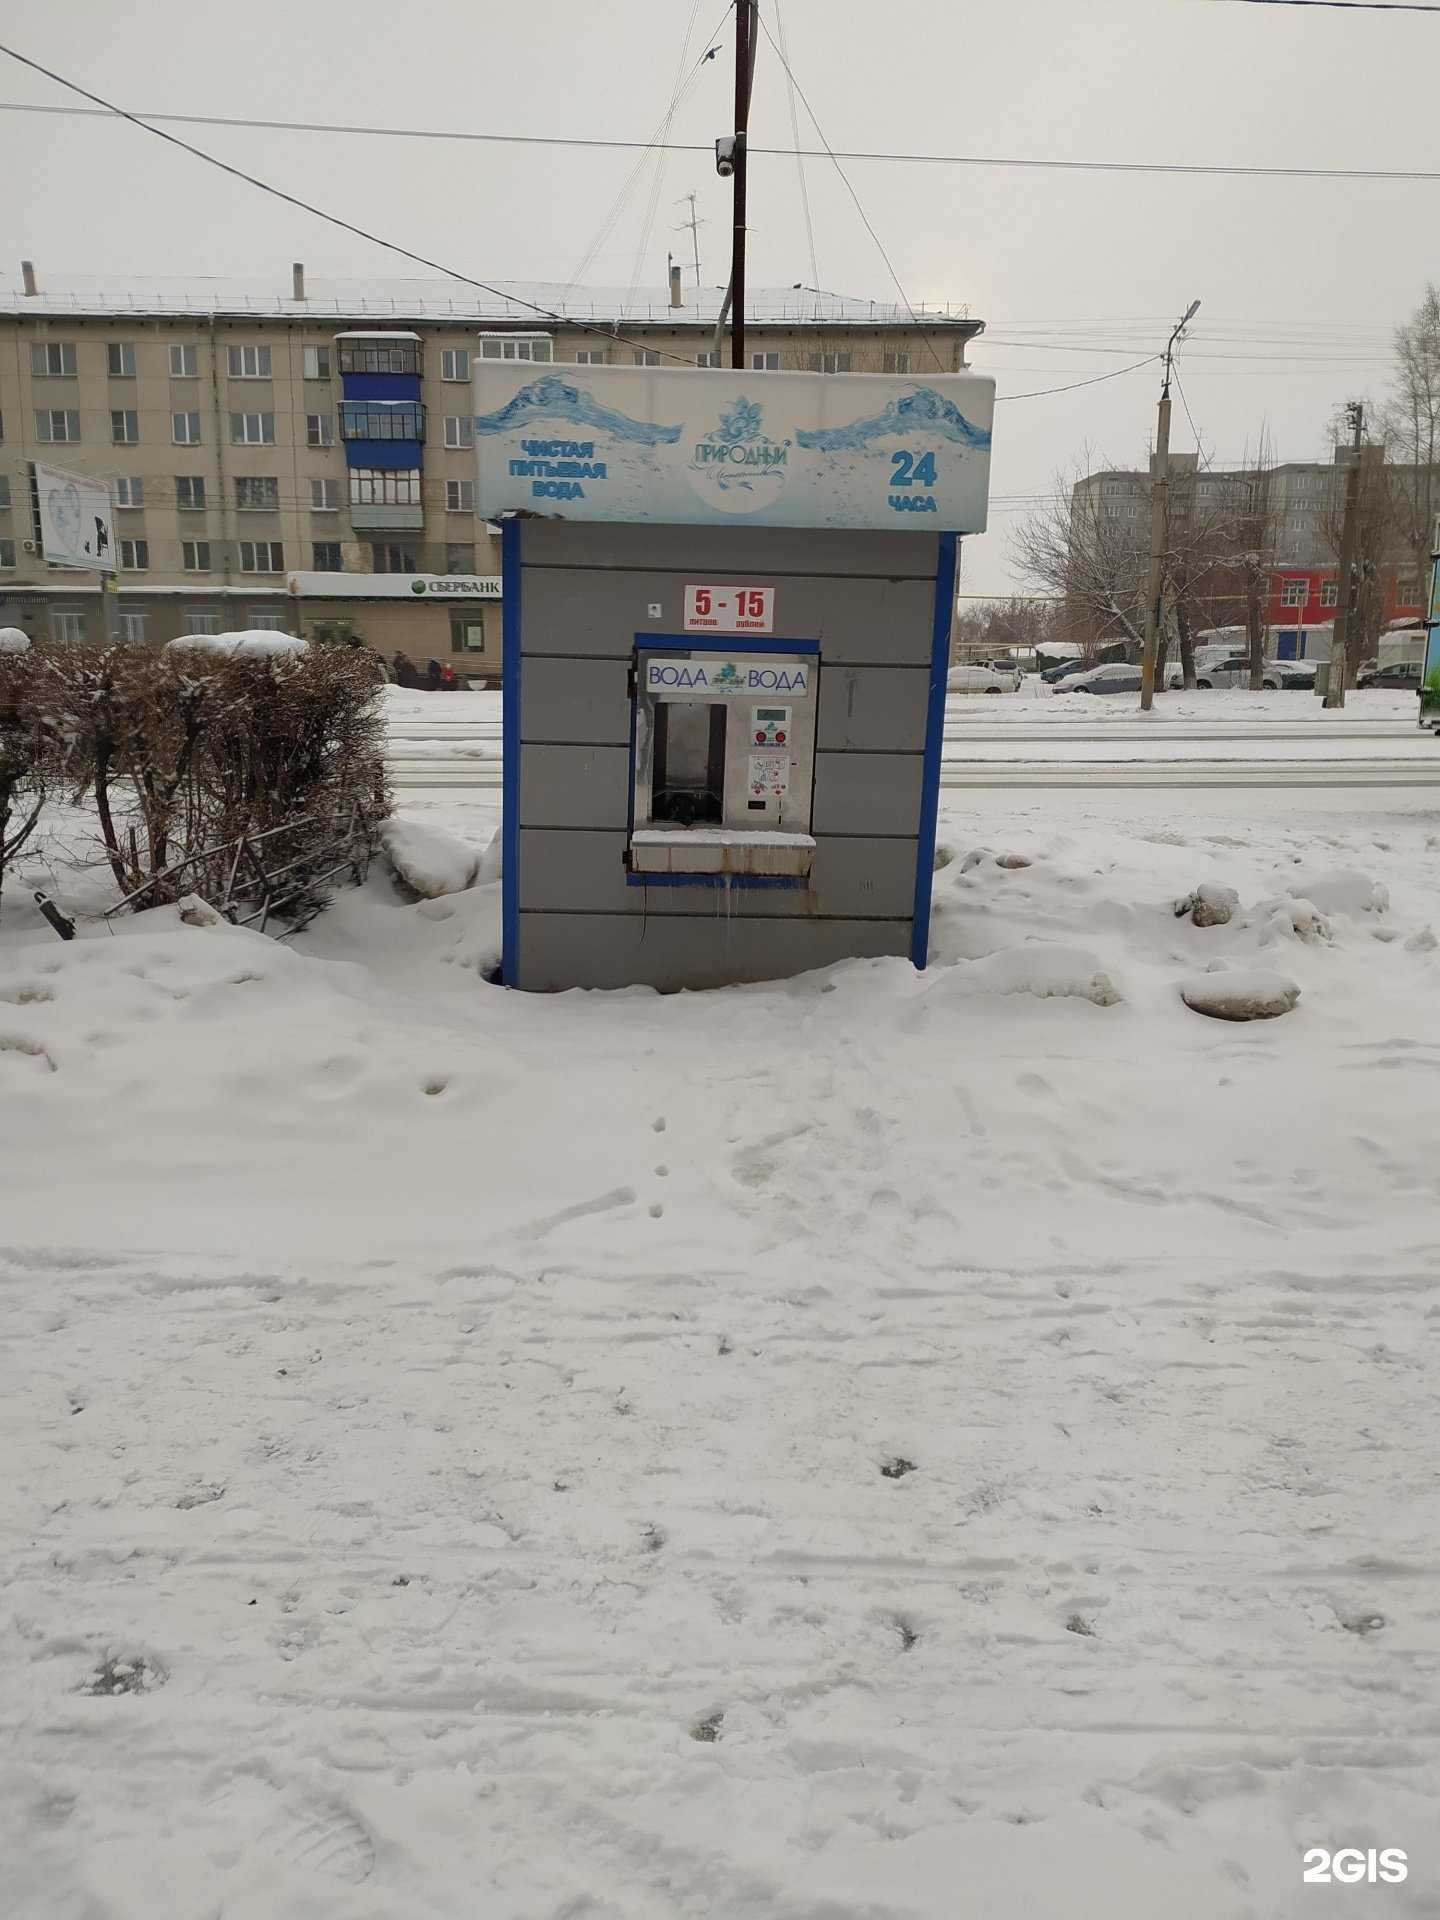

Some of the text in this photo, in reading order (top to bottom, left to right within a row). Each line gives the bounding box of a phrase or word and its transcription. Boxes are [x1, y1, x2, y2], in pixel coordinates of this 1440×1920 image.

[521, 439, 594, 459] ЧИСТАЯ
[508, 459, 608, 480] ПИТЬЕВАЯ
[889, 449, 938, 487] 24
[532, 480, 585, 501] ВОДА
[888, 495, 938, 512] ЧАСА
[429, 581, 500, 593] СБЕРБАНК
[695, 589, 711, 616] 5
[735, 591, 764, 618] 15
[649, 666, 708, 688] ВОДА
[748, 669, 807, 691] ВОДА
